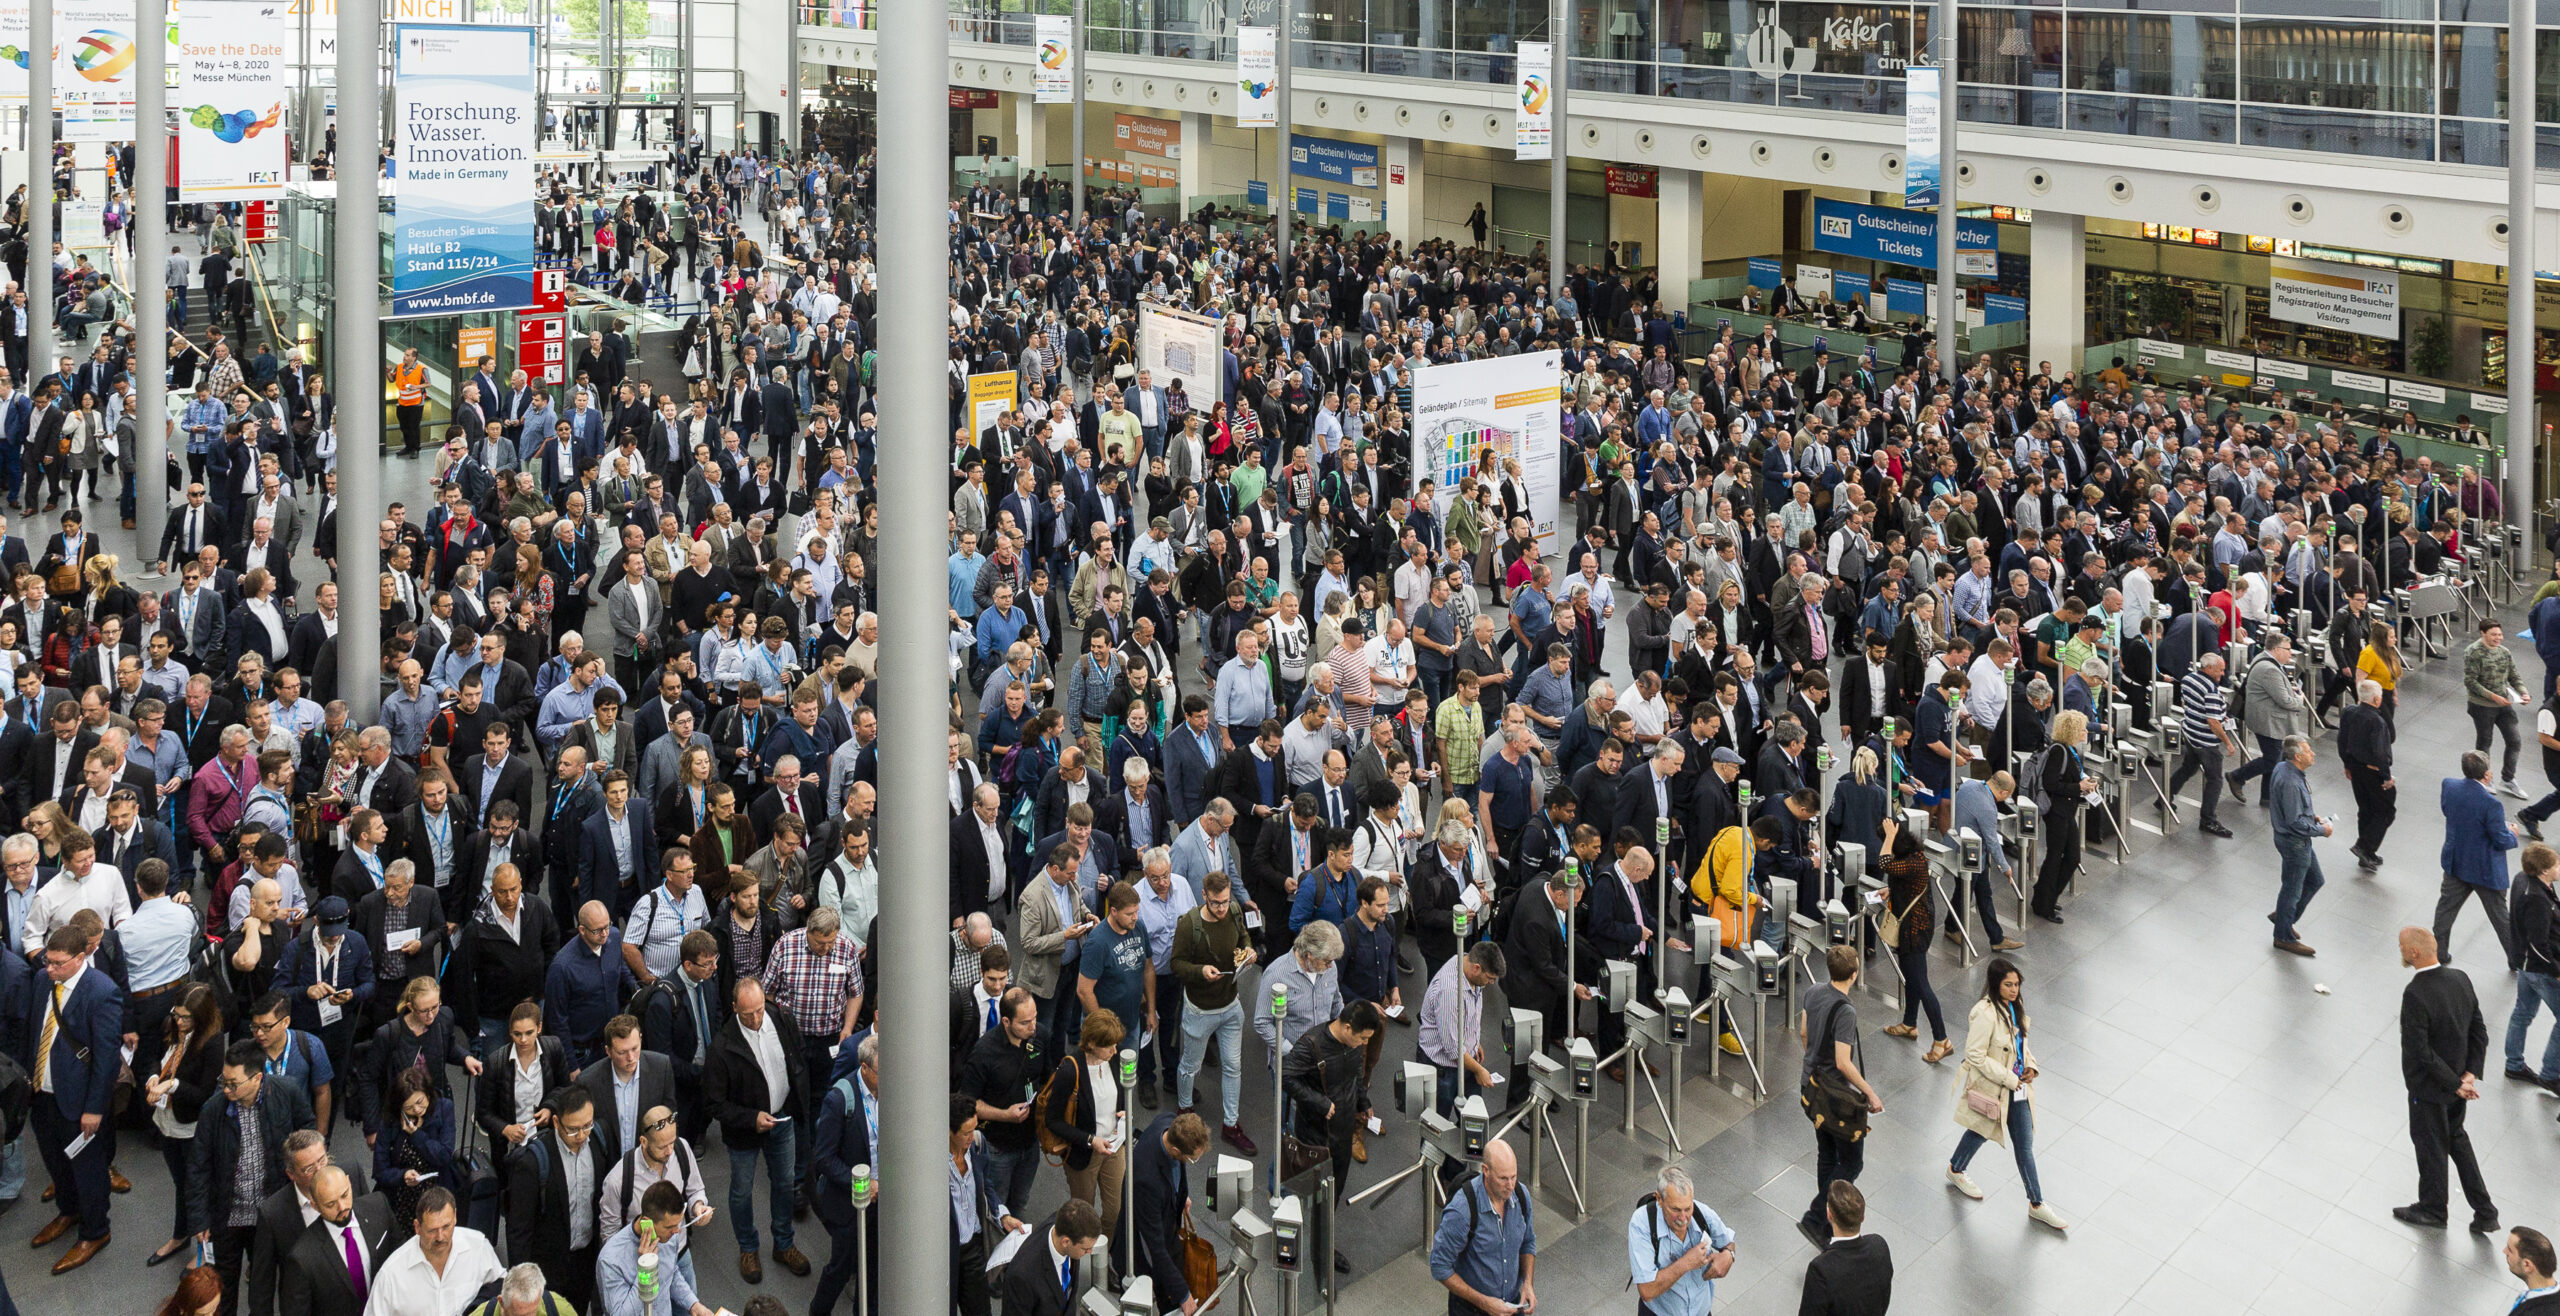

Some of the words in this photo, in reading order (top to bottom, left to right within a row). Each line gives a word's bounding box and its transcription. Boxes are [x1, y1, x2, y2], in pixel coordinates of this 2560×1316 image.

[984, 6, 997, 16] See
[1291, 20, 1310, 34] See
[1824, 16, 1893, 50] Käfer
[182, 43, 216, 56] Save
[221, 43, 245, 56] the
[250, 43, 282, 56] Date
[195, 61, 215, 71] May
[245, 60, 269, 69] 2020
[1877, 57, 1907, 70] am
[193, 74, 224, 82] Messe
[227, 73, 271, 82] München
[65, 92, 88, 100] IFAT
[409, 102, 521, 124] Forschung.
[408, 123, 485, 141] Wasser.
[1131, 120, 1167, 137] Gutscheine
[1137, 136, 1162, 150] Voucher
[409, 143, 527, 163] Innovation.
[1292, 149, 1307, 161] IFAT
[1309, 144, 1344, 158] Gutscheine
[1347, 150, 1374, 163] Voucher
[408, 169, 441, 180] Made
[444, 168, 455, 179] in
[457, 168, 509, 180] Germany
[1319, 162, 1342, 175] Tickets
[249, 171, 279, 183] IFAT
[408, 226, 458, 238] Besuchen
[460, 225, 475, 236] Sie
[477, 226, 498, 235] uns:
[1823, 219, 1849, 234] IFAT
[1857, 213, 1928, 236] Gutscheine
[408, 242, 442, 255] Halle
[445, 241, 461, 253] B2
[1877, 238, 1923, 258] Tickets
[408, 258, 444, 272] Stand
[447, 256, 498, 270] 115/214
[2367, 281, 2393, 295] IFAT
[408, 291, 495, 309] www.bmbf.de
[2275, 282, 2347, 303] Registrierleitung
[2350, 294, 2394, 309] Besucher
[2482, 297, 2506, 308] Press,
[2277, 295, 2331, 311] Registration
[2332, 304, 2392, 322] Management
[2316, 311, 2350, 325] Visitors
[984, 379, 1012, 388] Lufthansa
[1419, 400, 1457, 414] Geländeplan
[1463, 397, 1488, 407] Sitemap
[1538, 521, 1553, 533] IFAT
